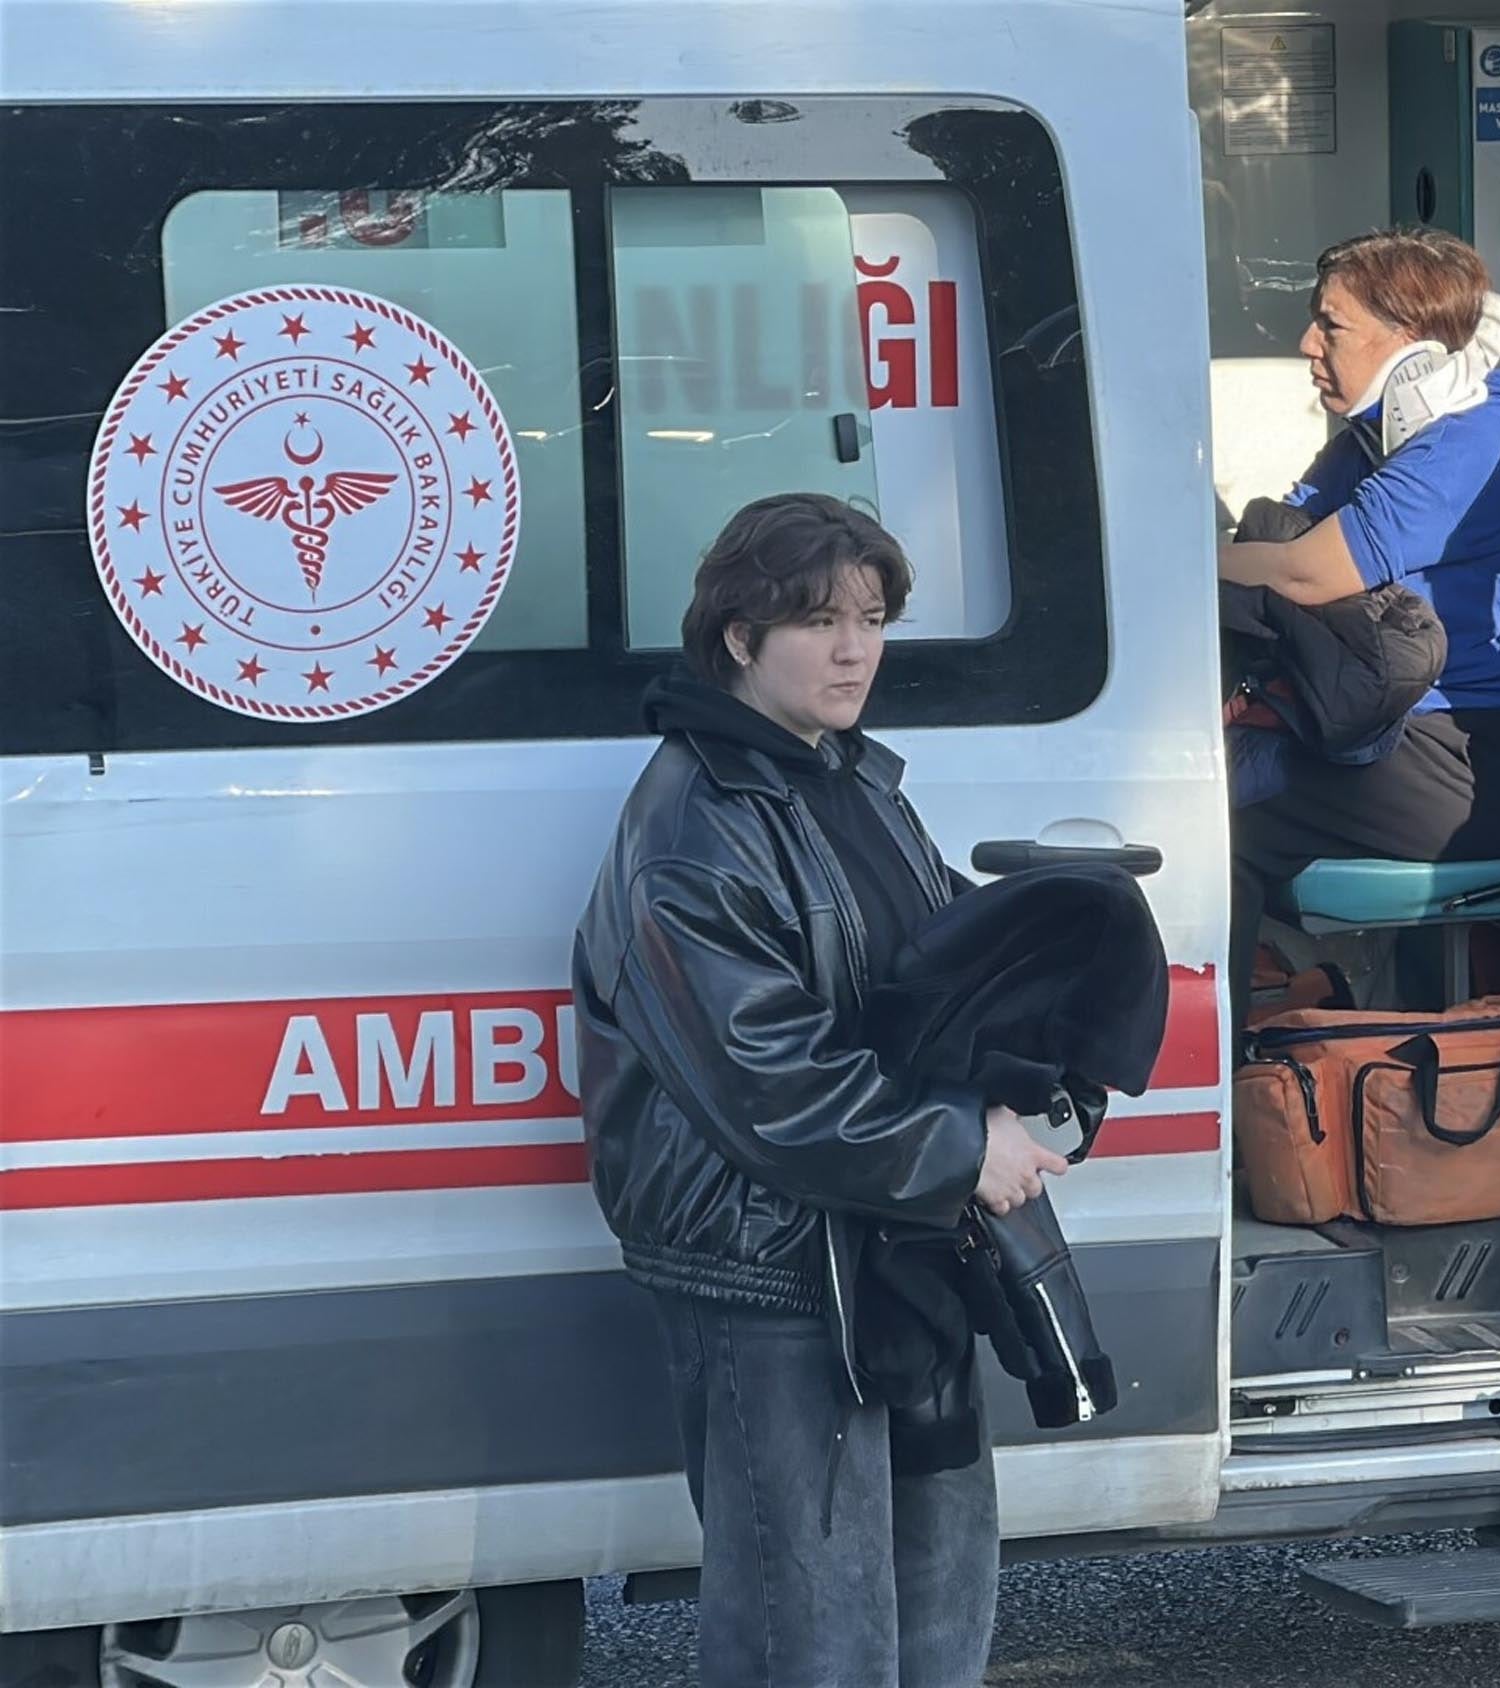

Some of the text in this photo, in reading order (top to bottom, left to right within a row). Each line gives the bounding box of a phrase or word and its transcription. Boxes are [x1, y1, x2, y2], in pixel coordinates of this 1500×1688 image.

[172, 363, 441, 627] TÜRKİYE CUMHURİYETİ SAĞLIK BAKANLIĞI
